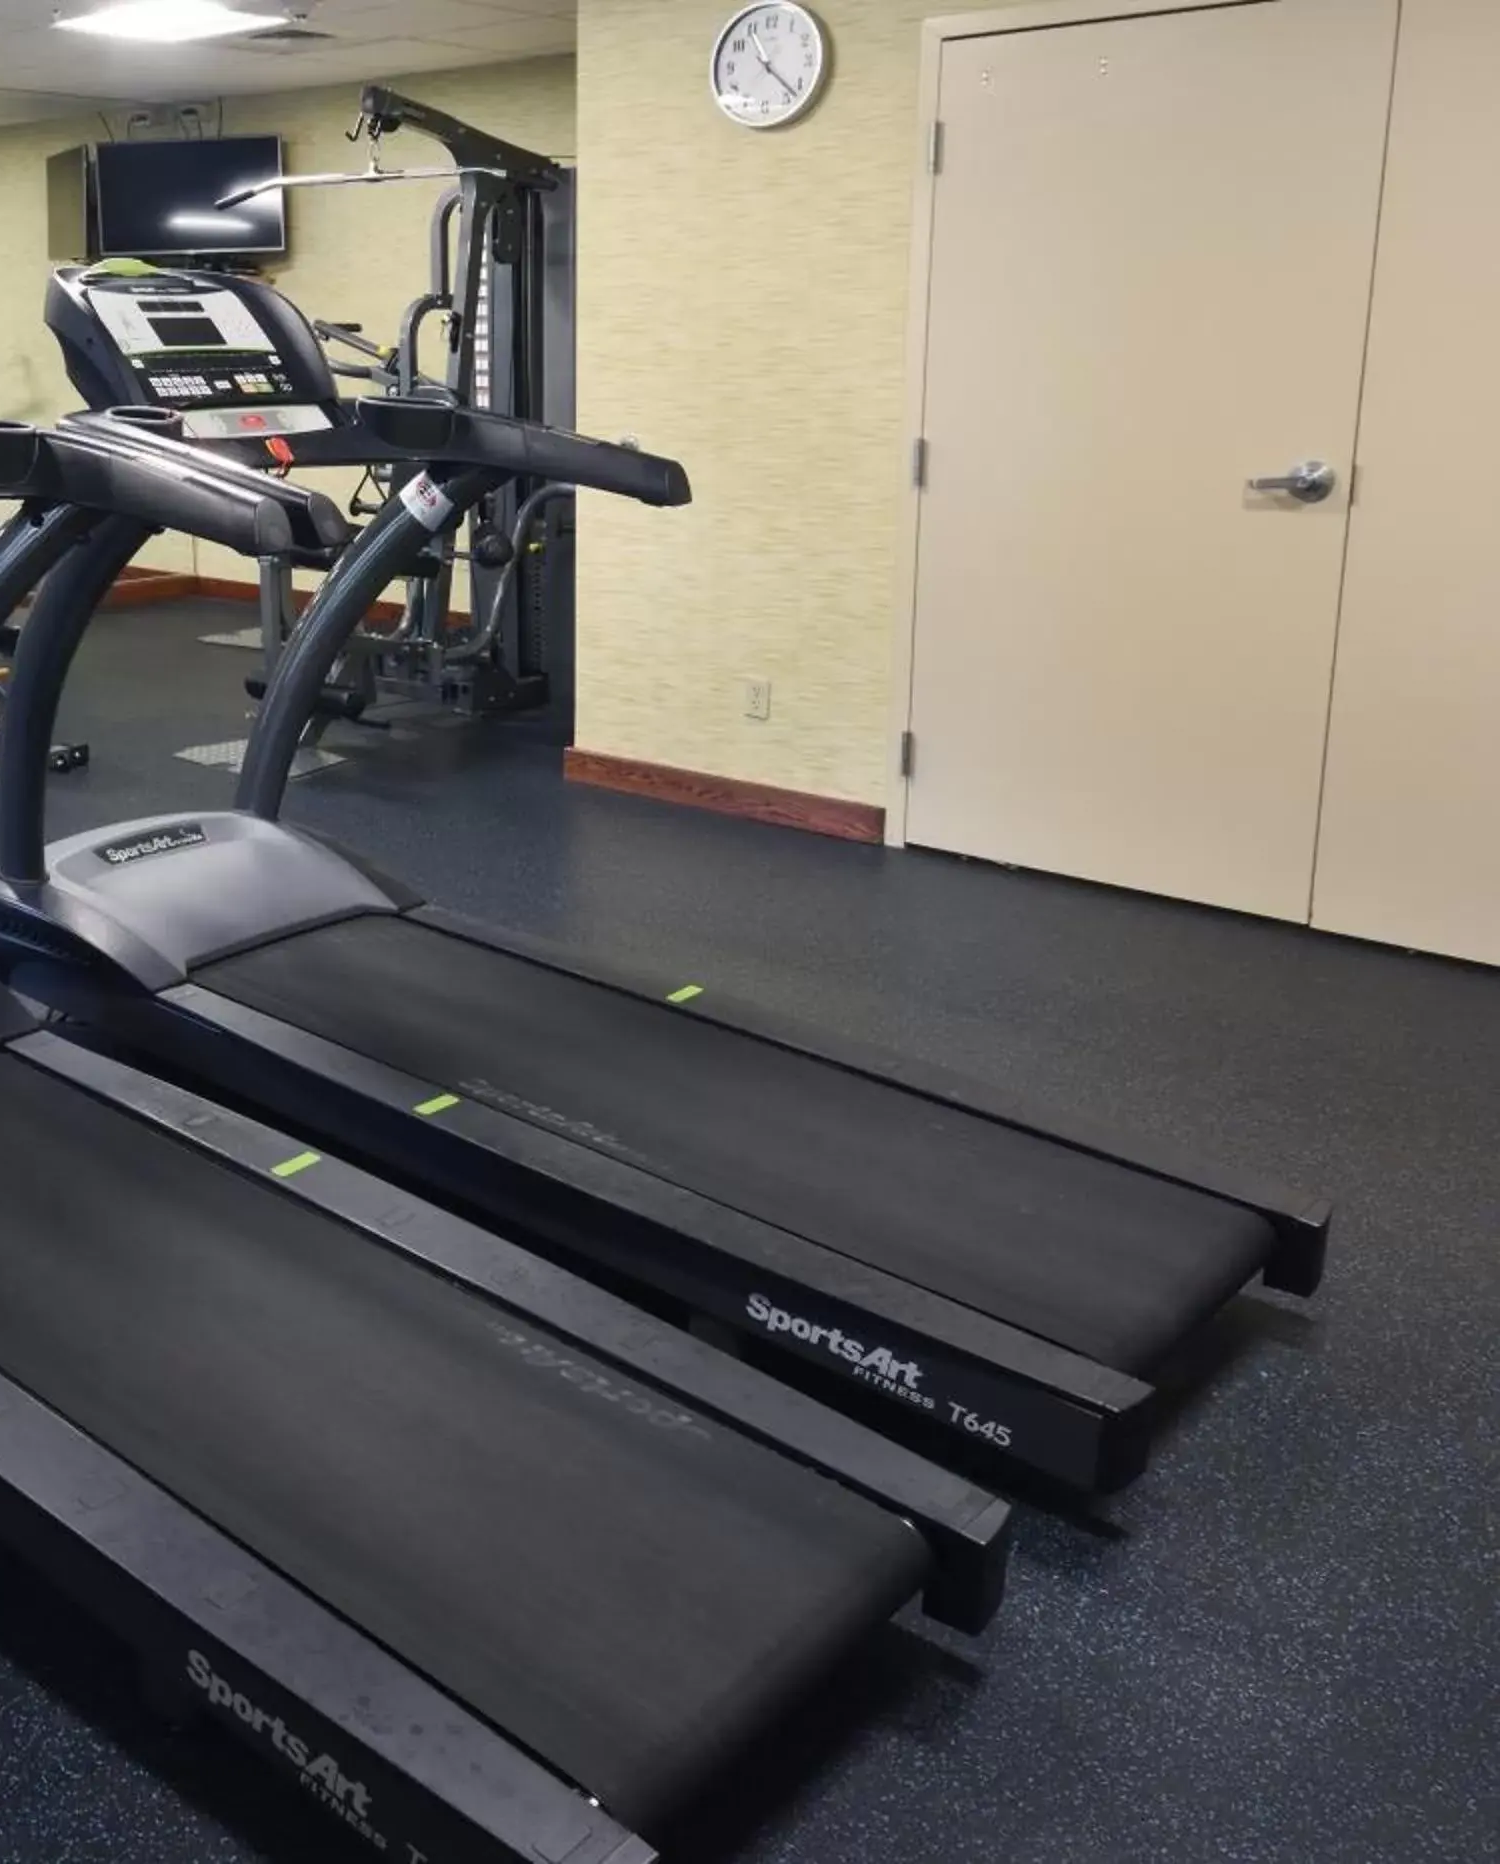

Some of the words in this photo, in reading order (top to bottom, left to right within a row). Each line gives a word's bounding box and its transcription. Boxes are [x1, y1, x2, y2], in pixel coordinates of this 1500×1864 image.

[746, 1292, 924, 1390] SportsArt
[853, 1365, 936, 1410] FITNESS
[948, 1401, 1013, 1447] T645
[186, 1649, 372, 1818] SportsArt
